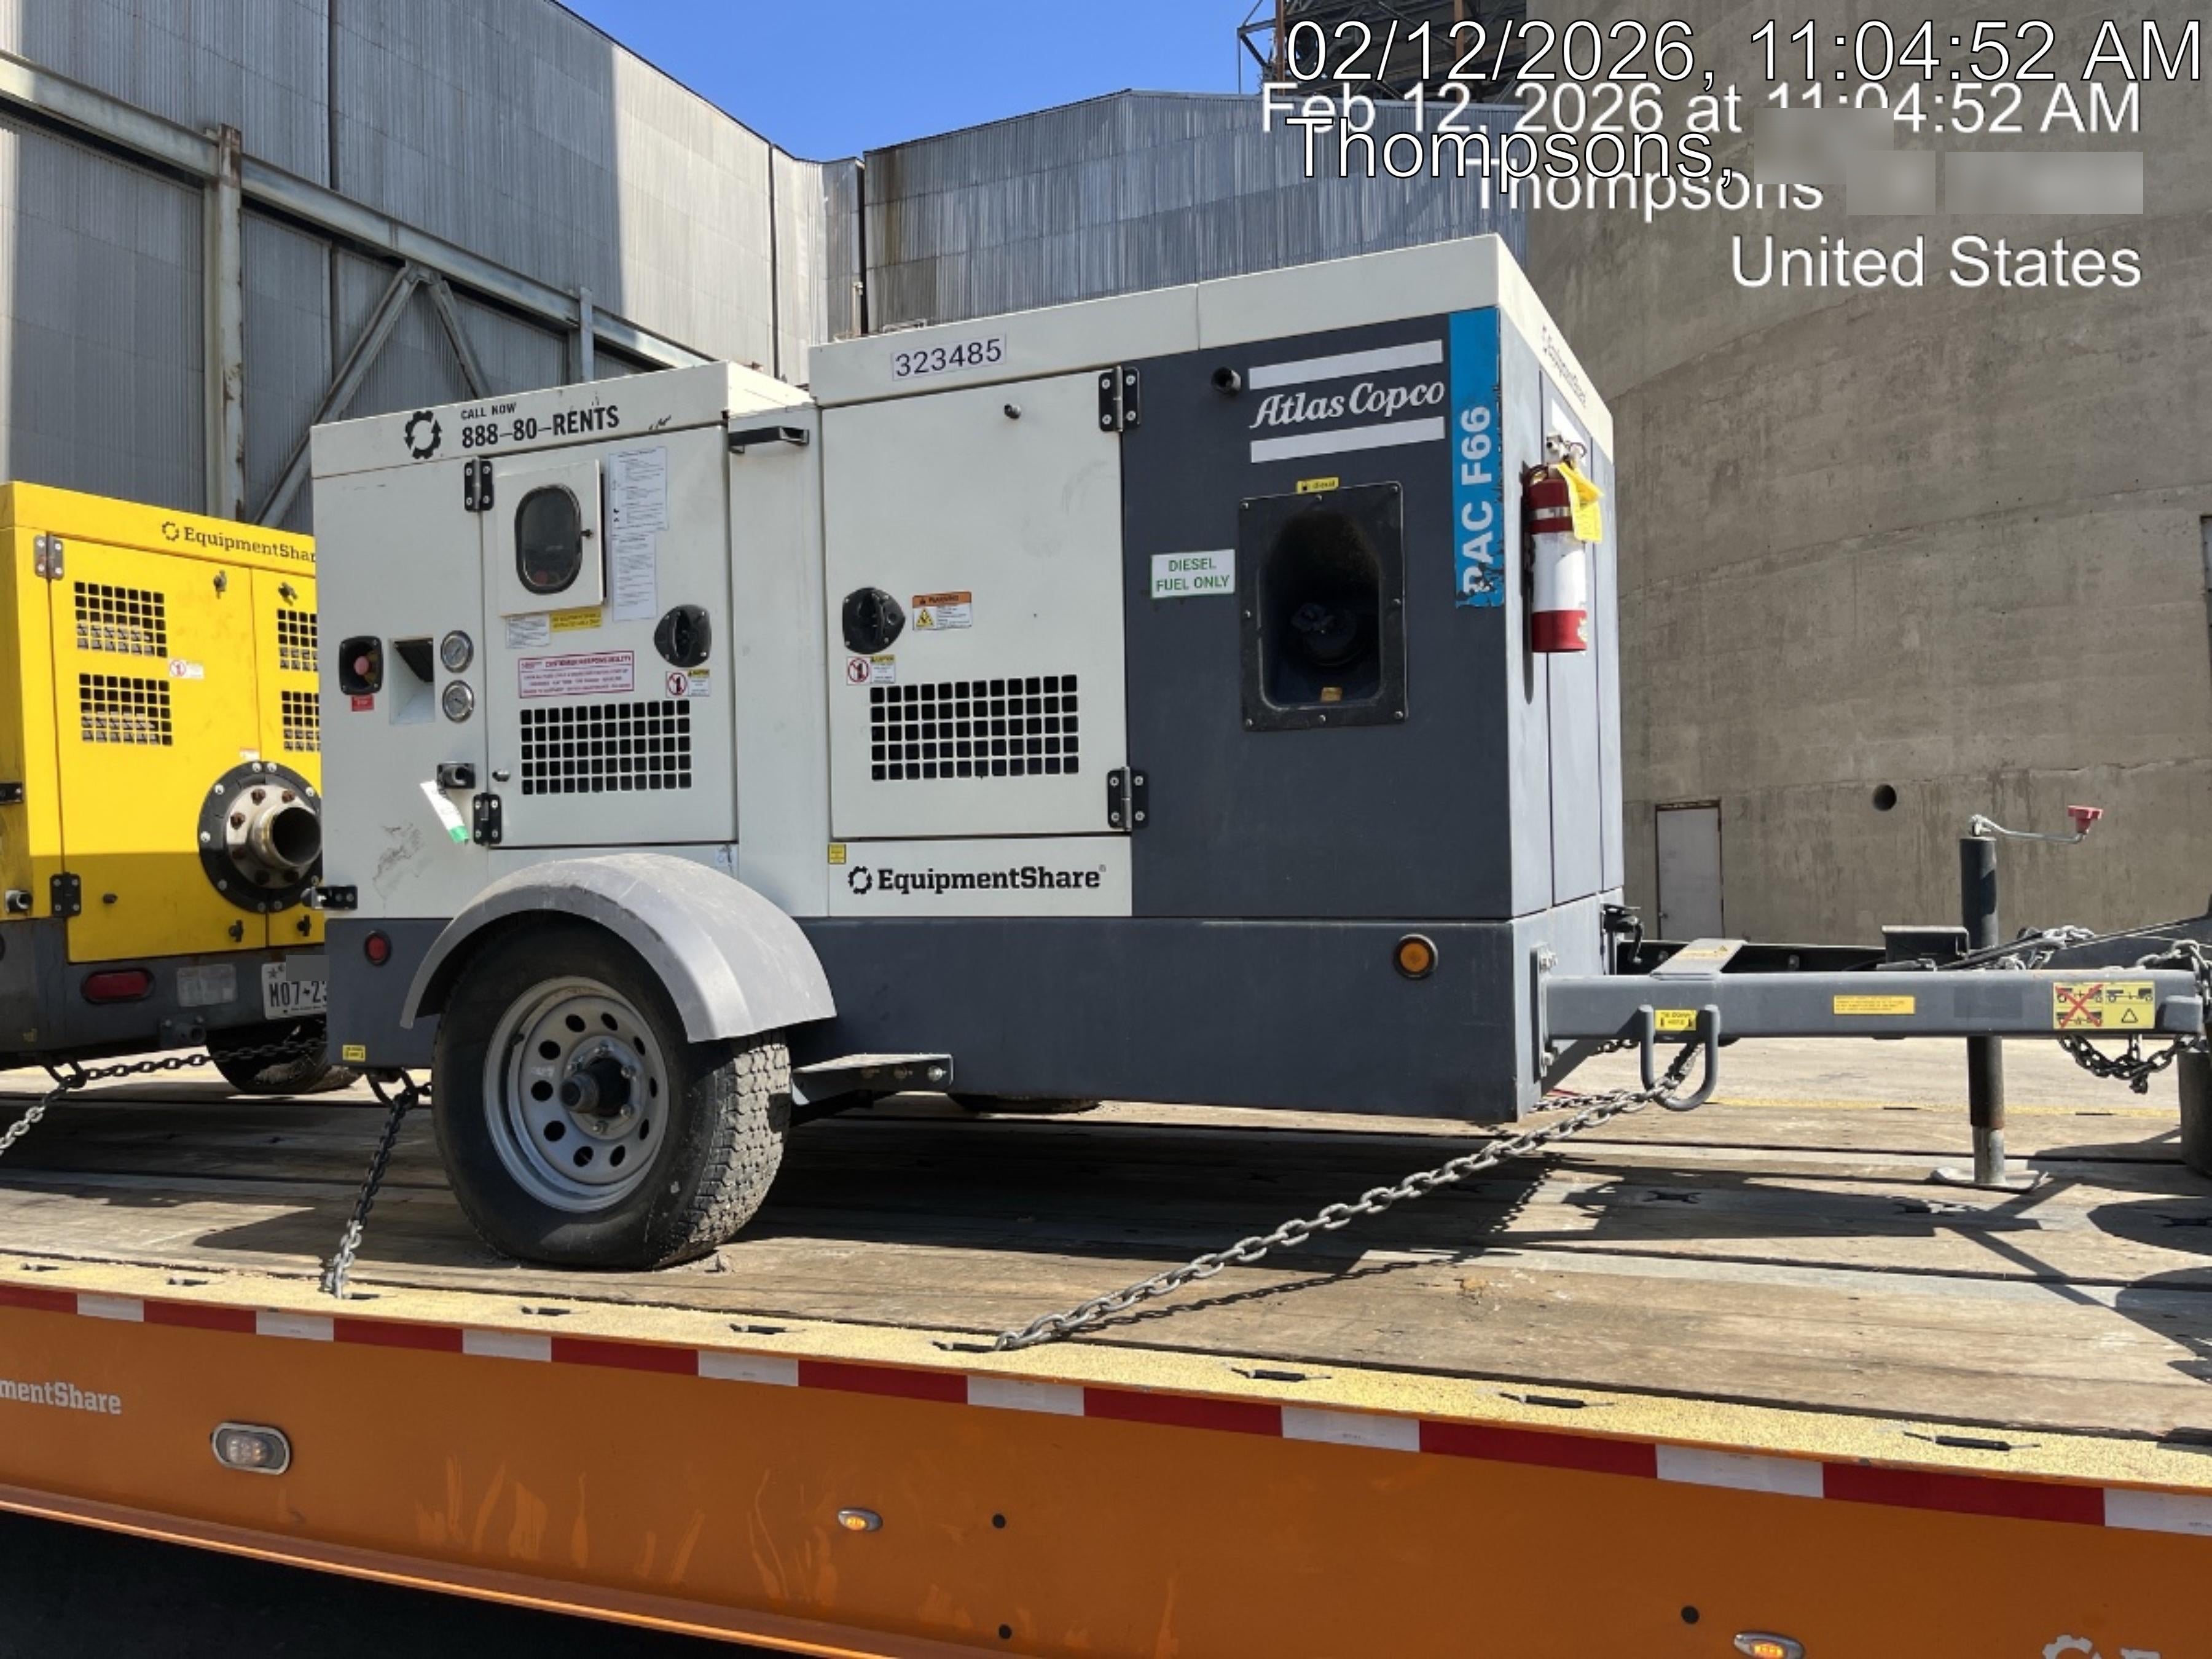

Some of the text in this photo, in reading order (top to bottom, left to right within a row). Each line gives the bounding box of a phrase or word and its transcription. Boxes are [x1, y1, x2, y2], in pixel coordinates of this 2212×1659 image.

[895, 339, 1002, 377] 323485
[461, 402, 517, 420] CALL NOW
[1249, 381, 1445, 429] Atlas Copco
[1460, 406, 1494, 594] PAC F66
[1168, 557, 1217, 572] DIESEL
[1156, 575, 1230, 592] FUEL ONLY
[877, 866, 1102, 895] EquipmentShare
